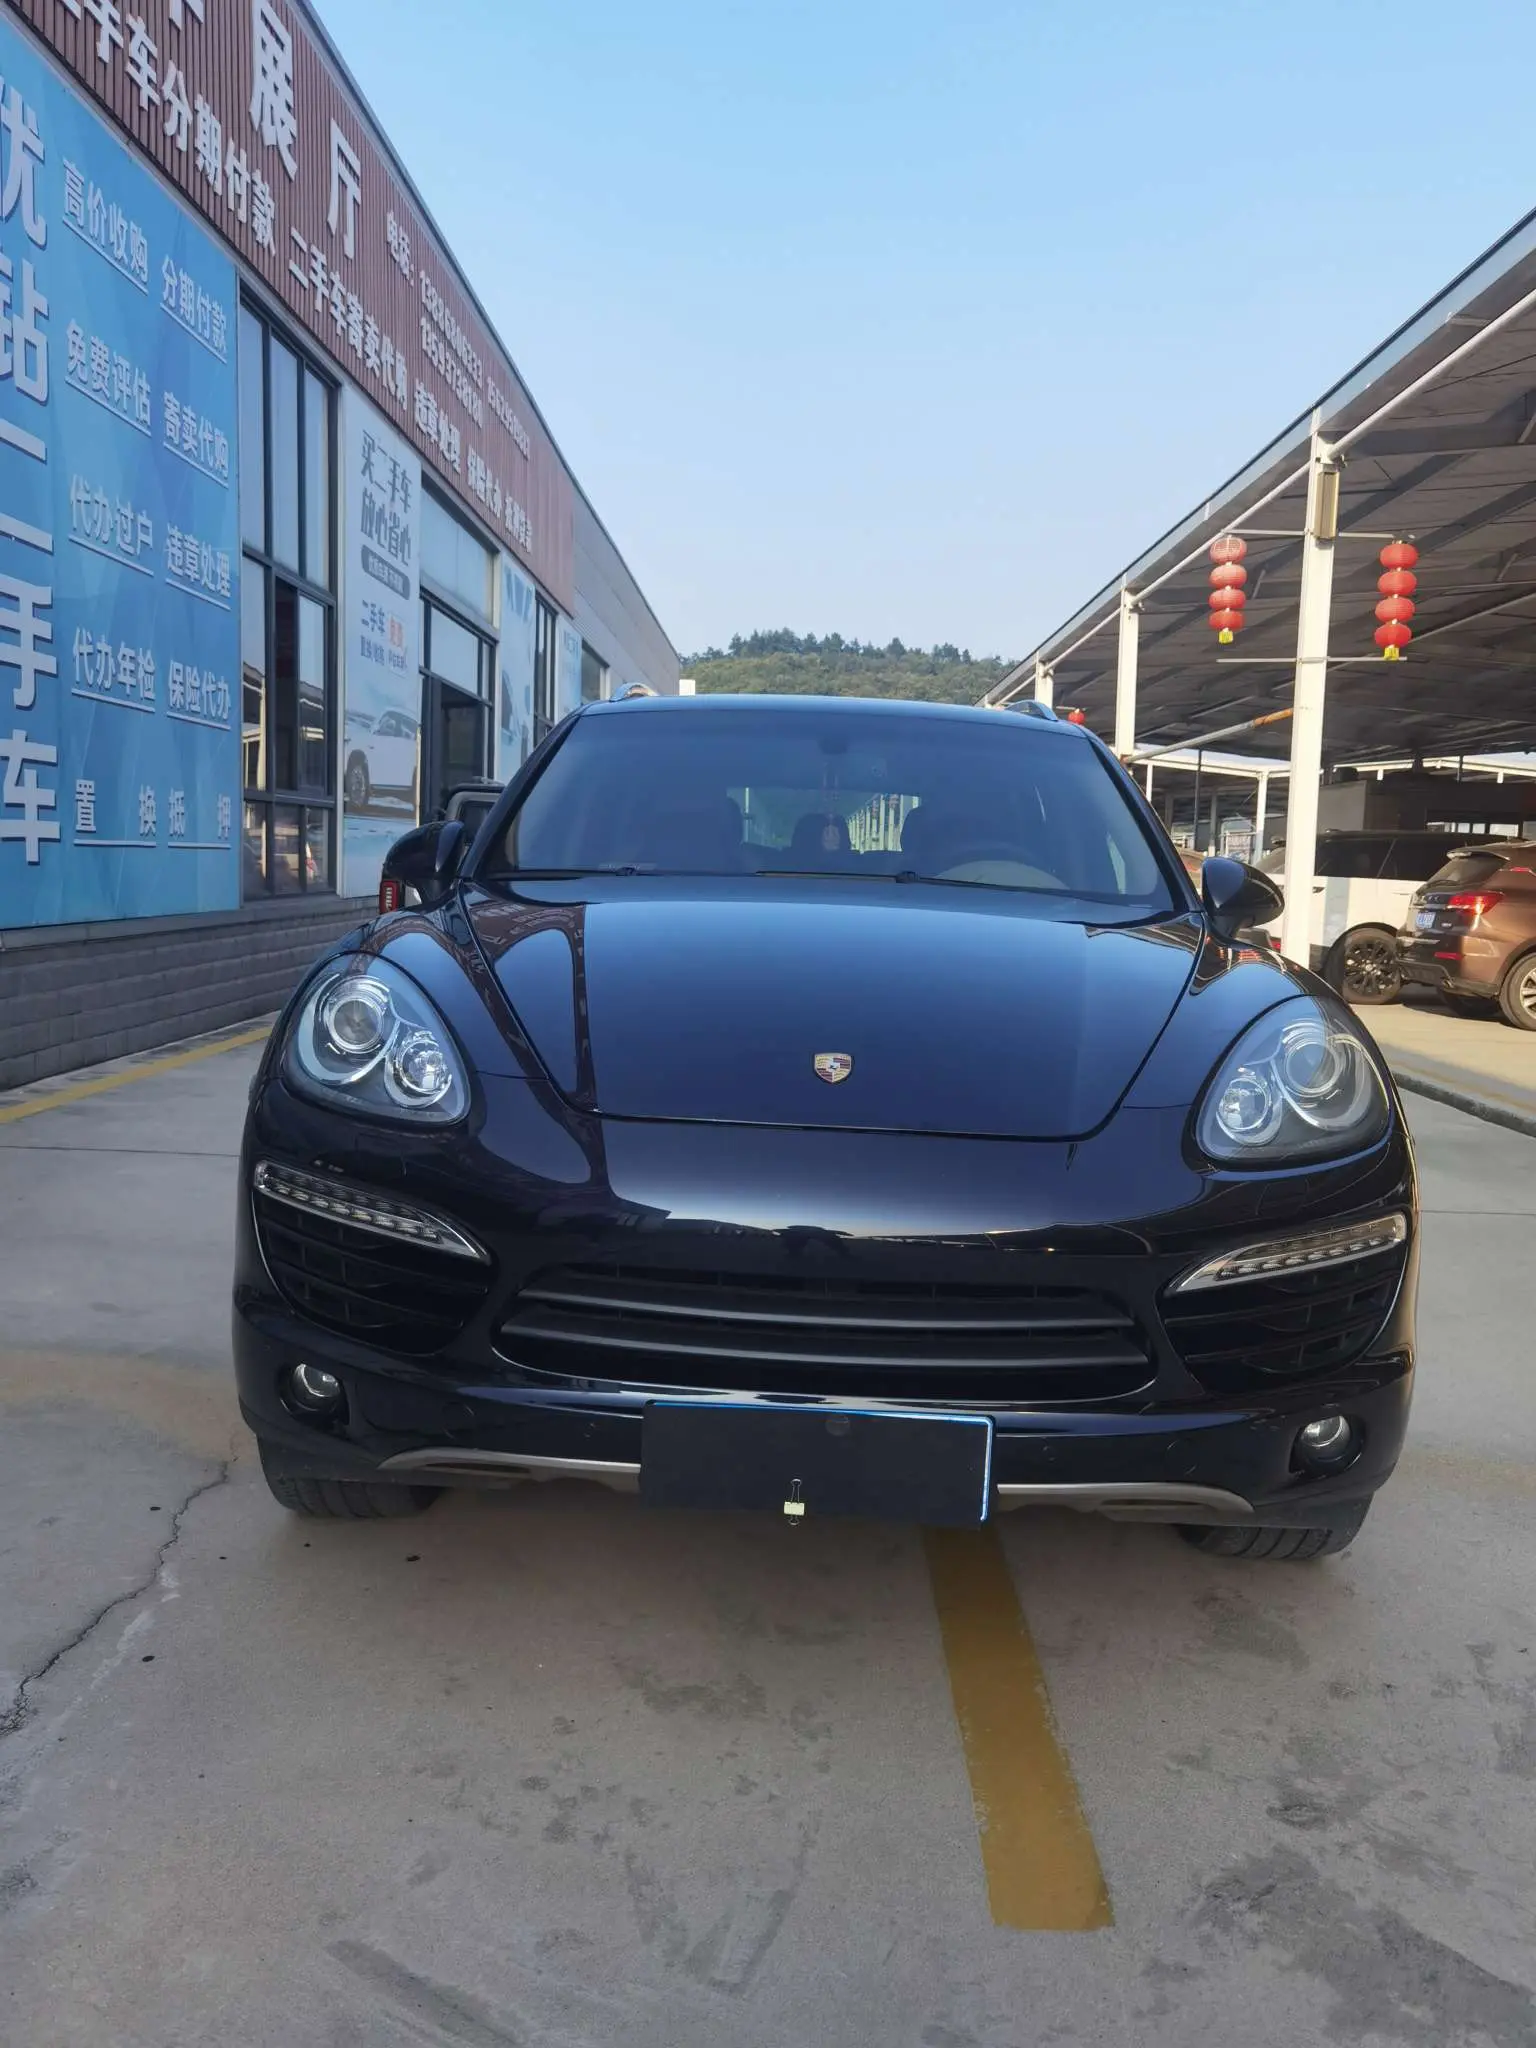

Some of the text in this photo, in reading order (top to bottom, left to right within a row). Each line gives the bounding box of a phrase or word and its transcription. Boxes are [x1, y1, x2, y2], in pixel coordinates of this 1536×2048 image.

[62, 0, 276, 257] 手车分期付款
[289, 227, 408, 412] 二手车寄卖代购
[414, 378, 461, 475] 违章处理
[63, 156, 228, 353] 高价收购 分期付款
[66, 318, 229, 480] 免费评估 寄卖代购
[361, 429, 413, 514] 买二手车
[361, 486, 412, 568] 放心省心
[69, 474, 231, 600] 代办过户 违章处理
[72, 627, 231, 720] 代办年检 保险代办
